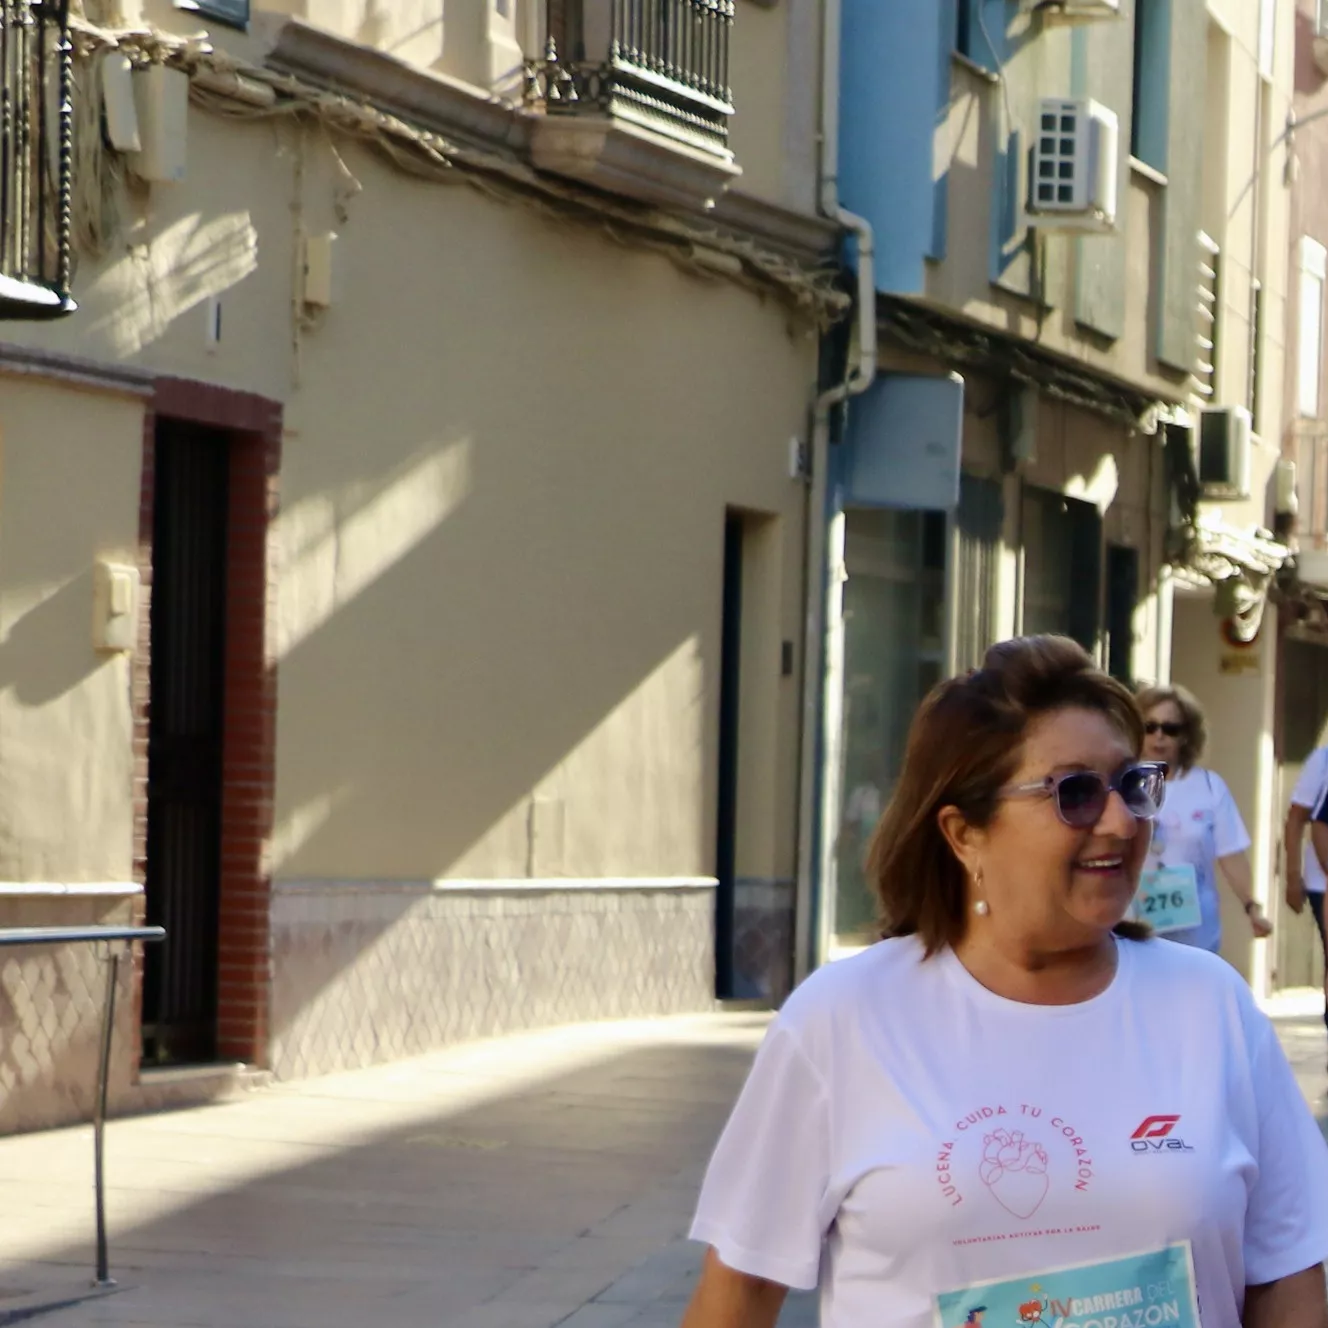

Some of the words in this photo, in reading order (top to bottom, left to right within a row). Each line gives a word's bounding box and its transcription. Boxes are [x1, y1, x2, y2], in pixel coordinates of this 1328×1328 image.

[1145, 890, 1183, 914] 276
[956, 1105, 1007, 1131] CUIDA
[1020, 1104, 1042, 1118] TU
[1050, 1297, 1073, 1318] IV
[1072, 1286, 1144, 1317] CARRERA
